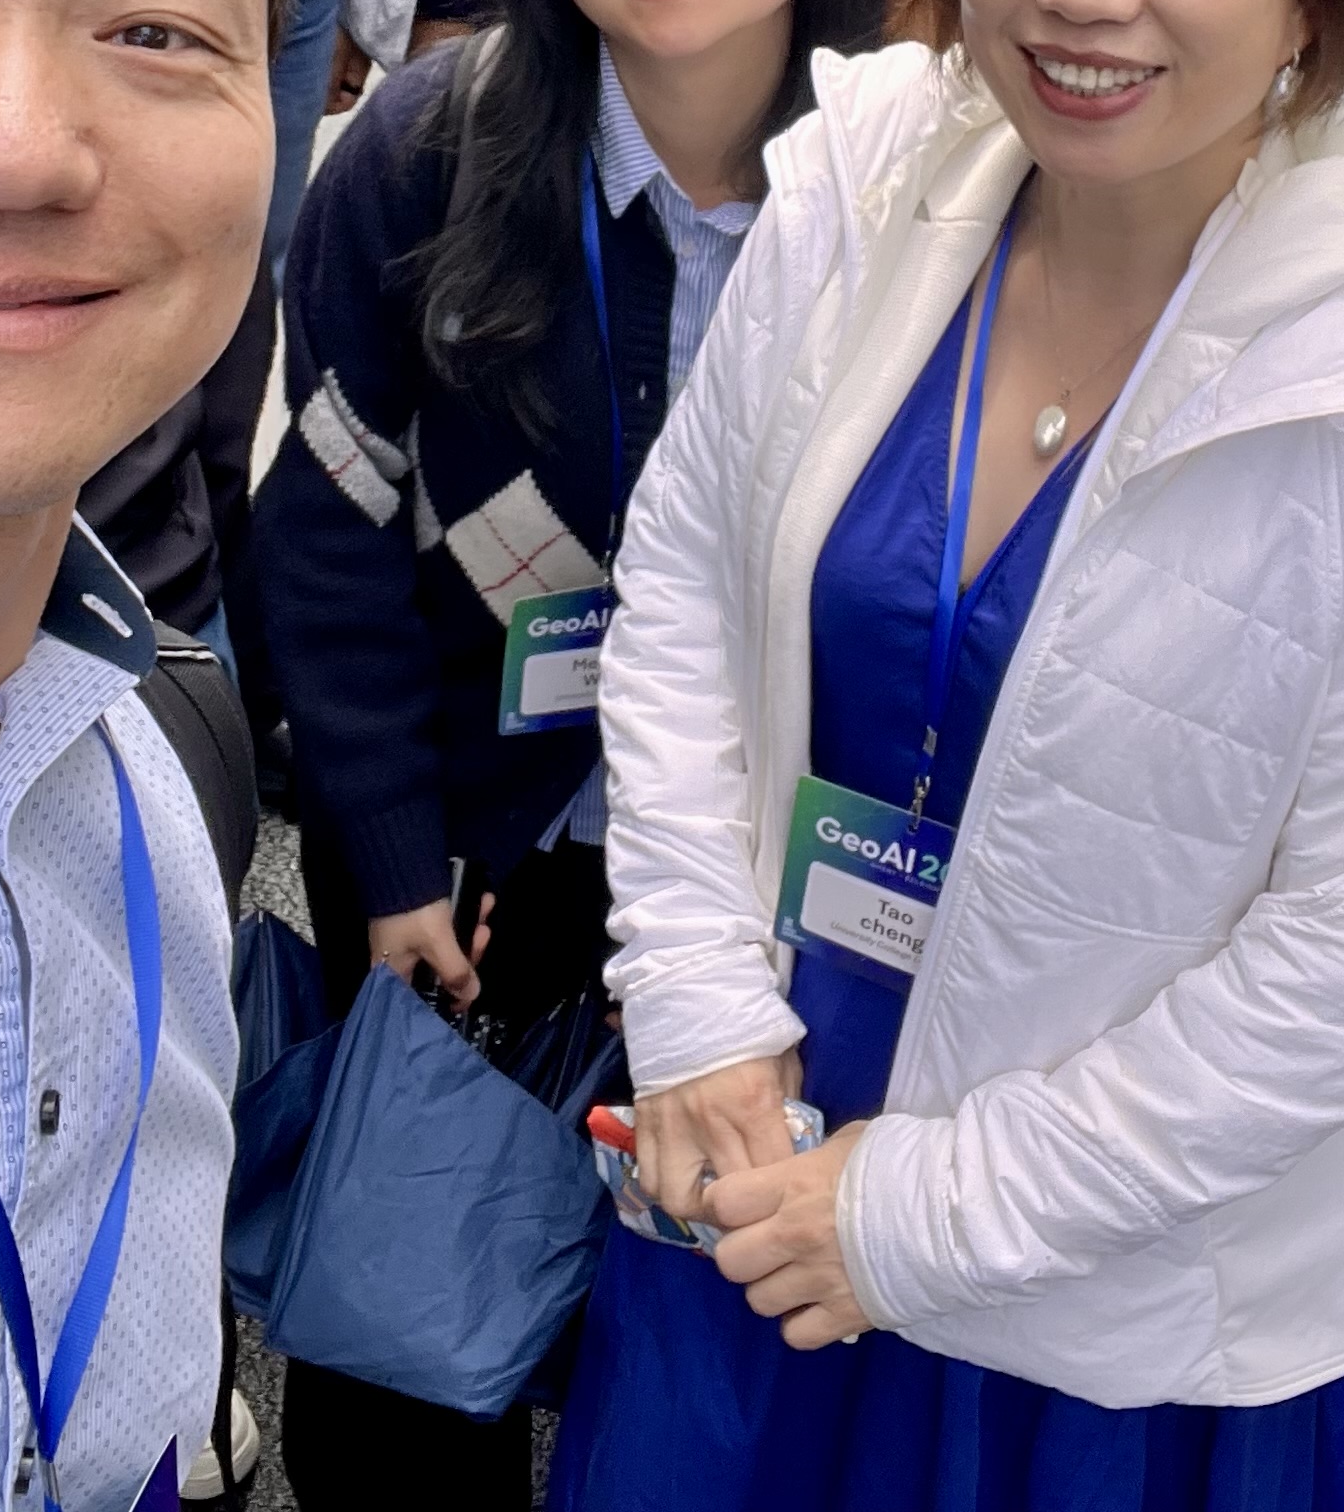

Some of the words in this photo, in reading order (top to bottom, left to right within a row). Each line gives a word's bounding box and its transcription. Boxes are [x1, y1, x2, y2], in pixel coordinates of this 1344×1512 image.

[527, 608, 609, 638] GeoAI
[816, 816, 917, 874] GeoAI
[879, 899, 914, 925] Tao
[860, 917, 926, 955] cheng
